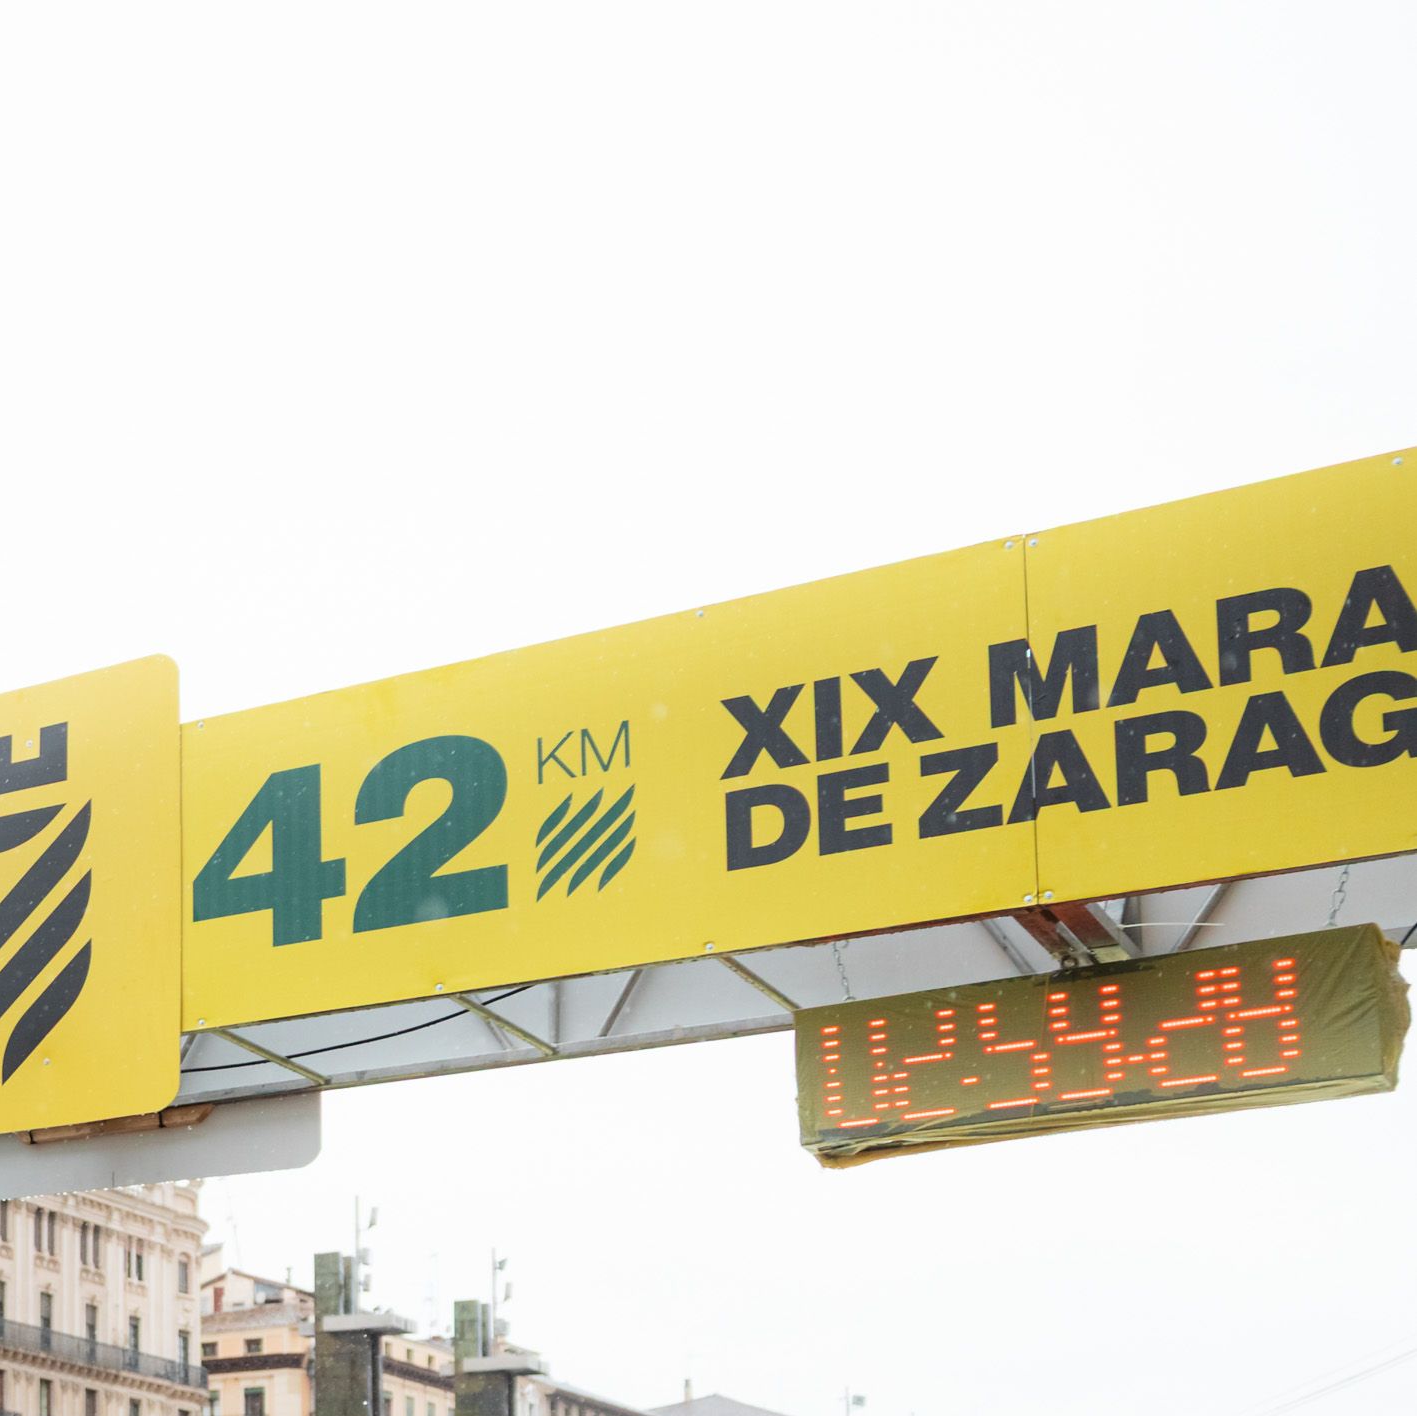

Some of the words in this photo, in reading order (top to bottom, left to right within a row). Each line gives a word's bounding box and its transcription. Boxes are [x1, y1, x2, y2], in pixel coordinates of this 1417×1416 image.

[719, 656, 945, 781] XIX
[988, 564, 1417, 729] MARA
[724, 763, 894, 872] DE
[918, 669, 1417, 839] ZARAG
[193, 734, 509, 948] 42
[537, 719, 631, 784] KM
